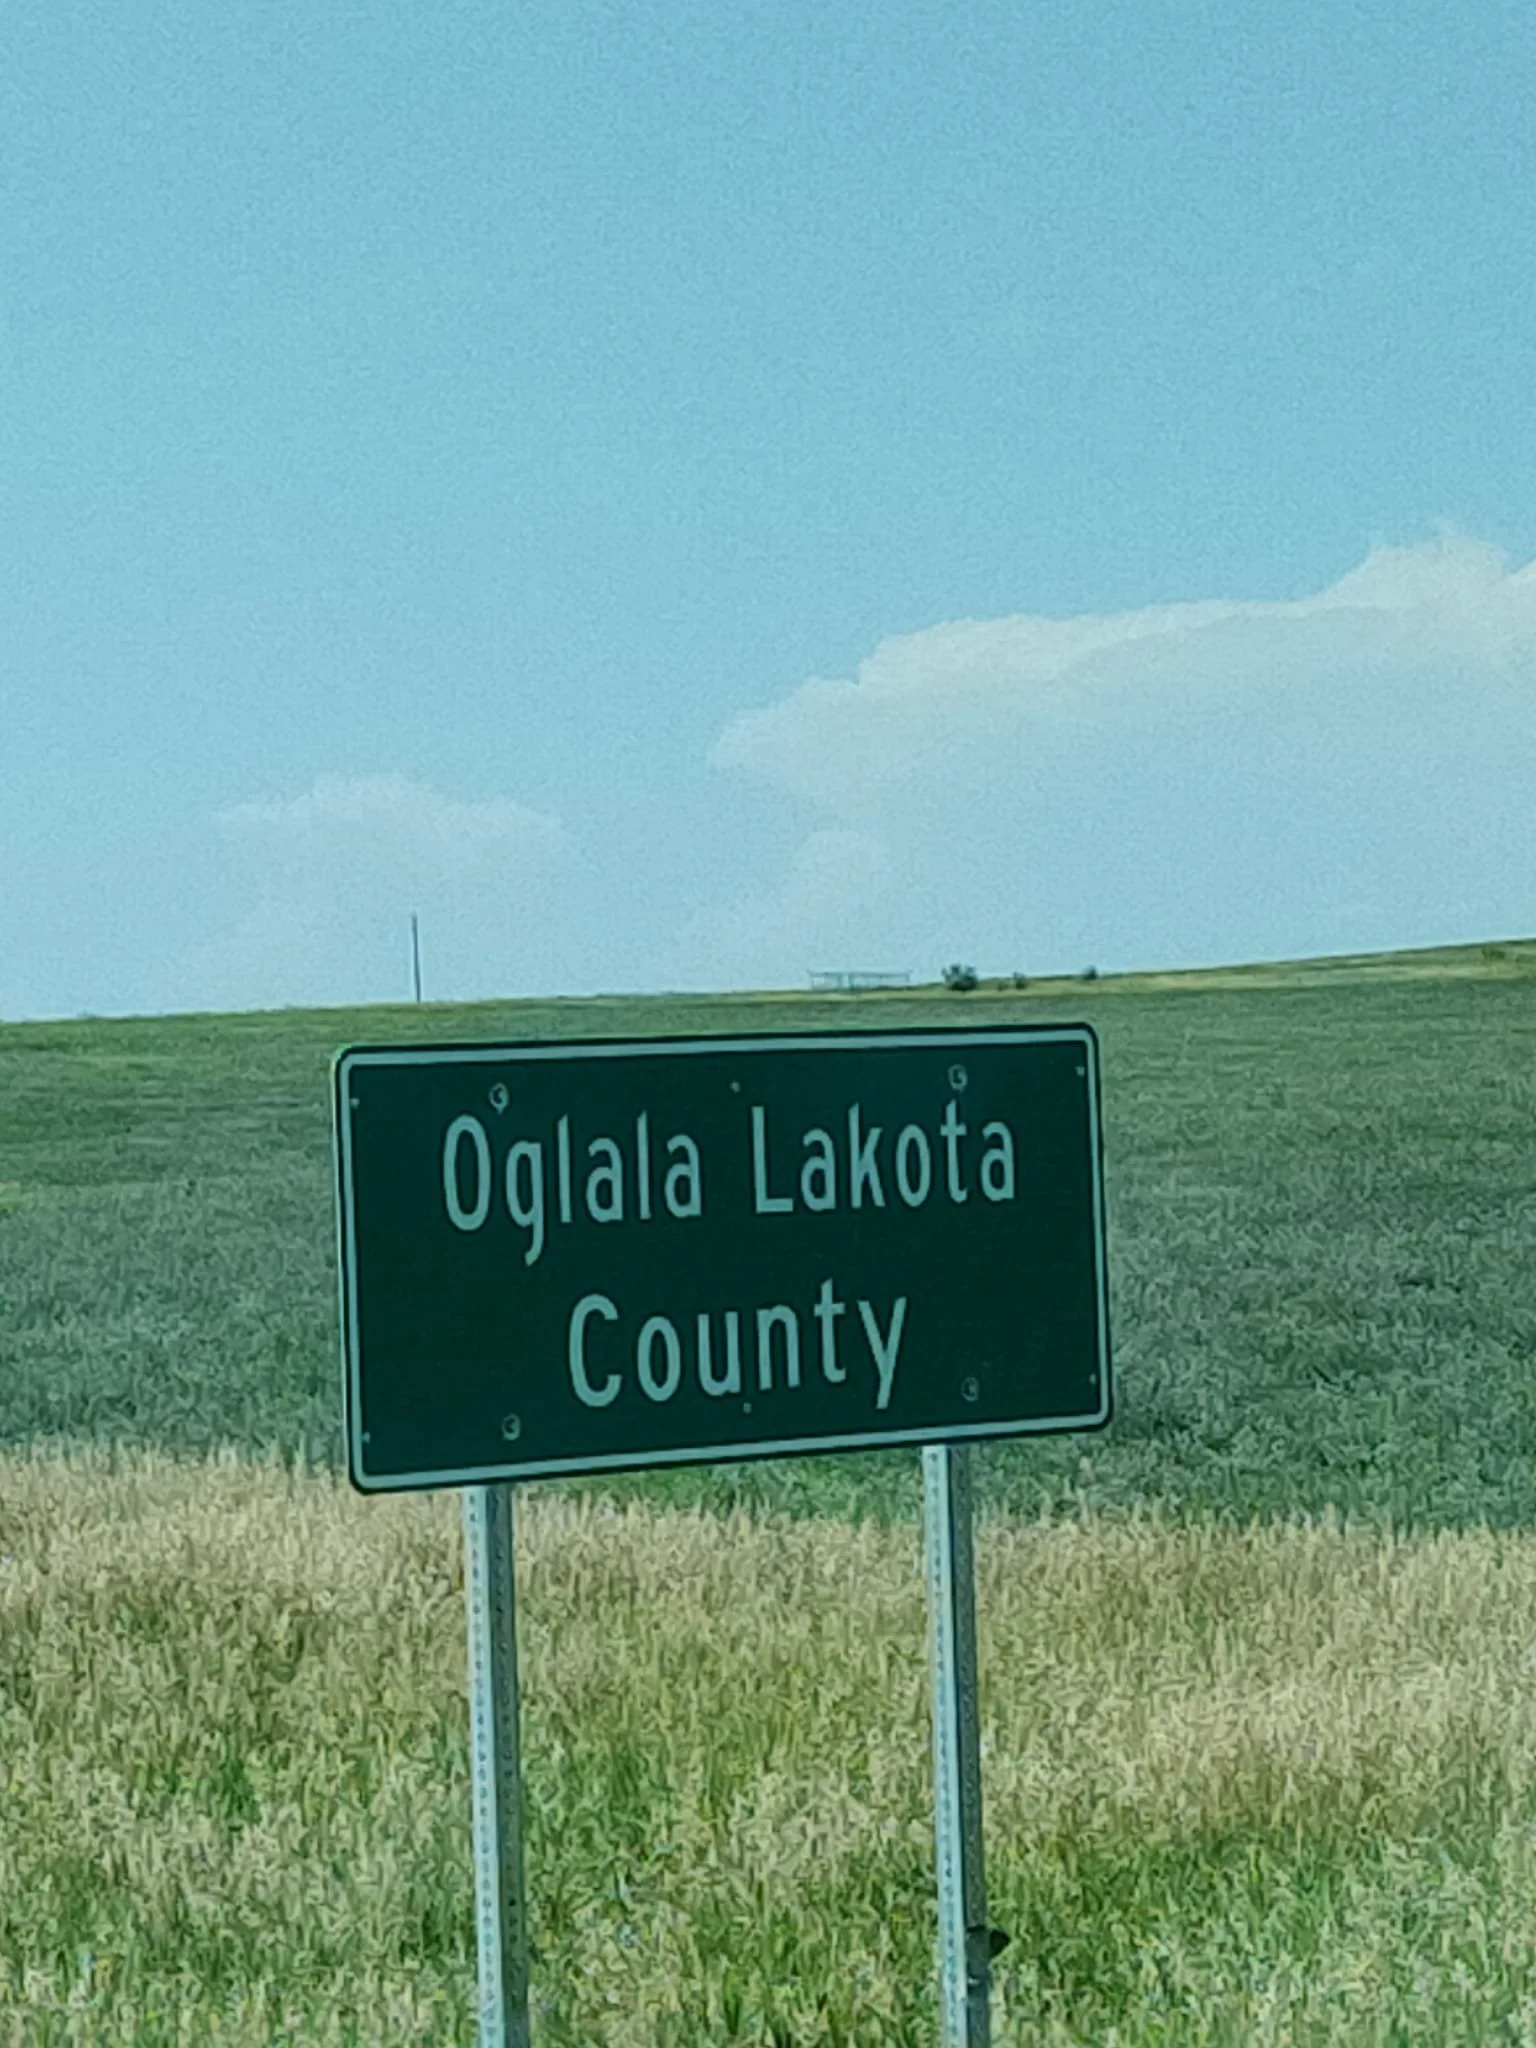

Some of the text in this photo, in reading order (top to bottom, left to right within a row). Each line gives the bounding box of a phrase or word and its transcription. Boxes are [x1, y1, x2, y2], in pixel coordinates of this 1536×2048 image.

[442, 1099, 1016, 1267] Oglala Lakota
[567, 1279, 908, 1410] County
